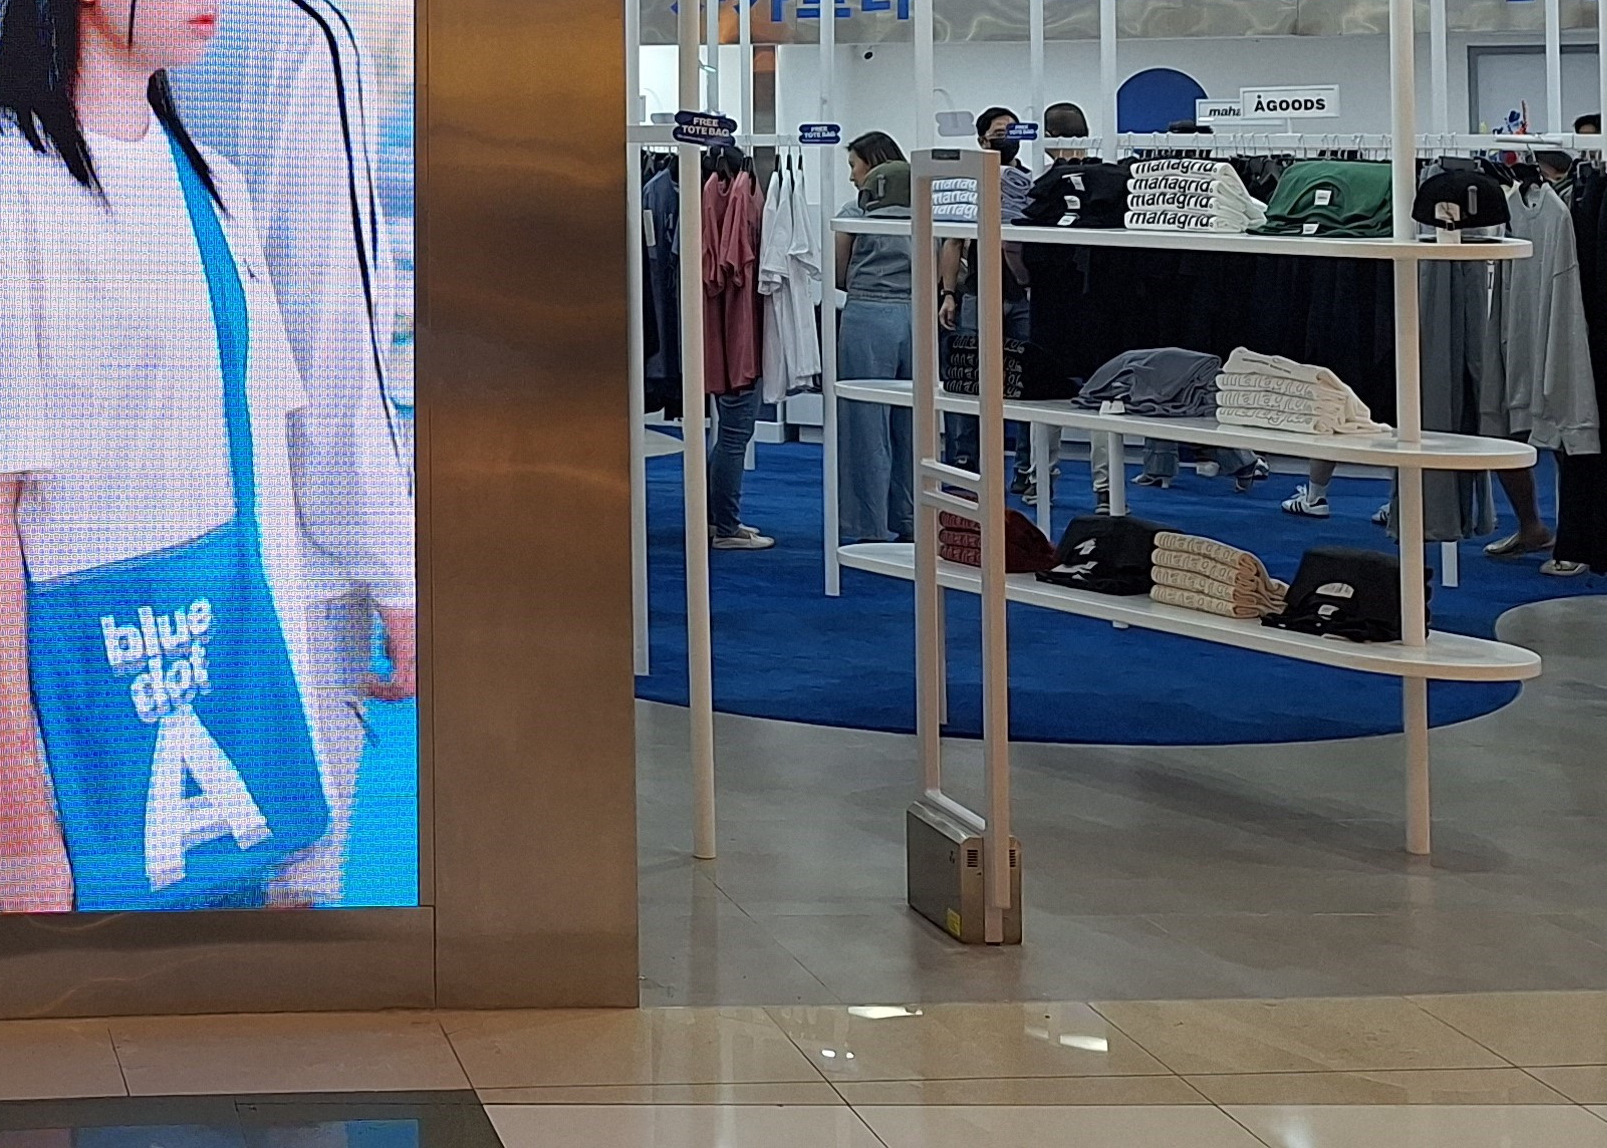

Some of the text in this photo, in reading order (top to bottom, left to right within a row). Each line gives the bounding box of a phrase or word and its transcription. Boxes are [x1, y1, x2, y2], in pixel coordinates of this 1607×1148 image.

[1254, 94, 1326, 112] ÅGOODS
[682, 125, 730, 137] TOTE BAG
[693, 117, 719, 127] FREE
[100, 597, 212, 668] blue
[144, 704, 274, 892] A
